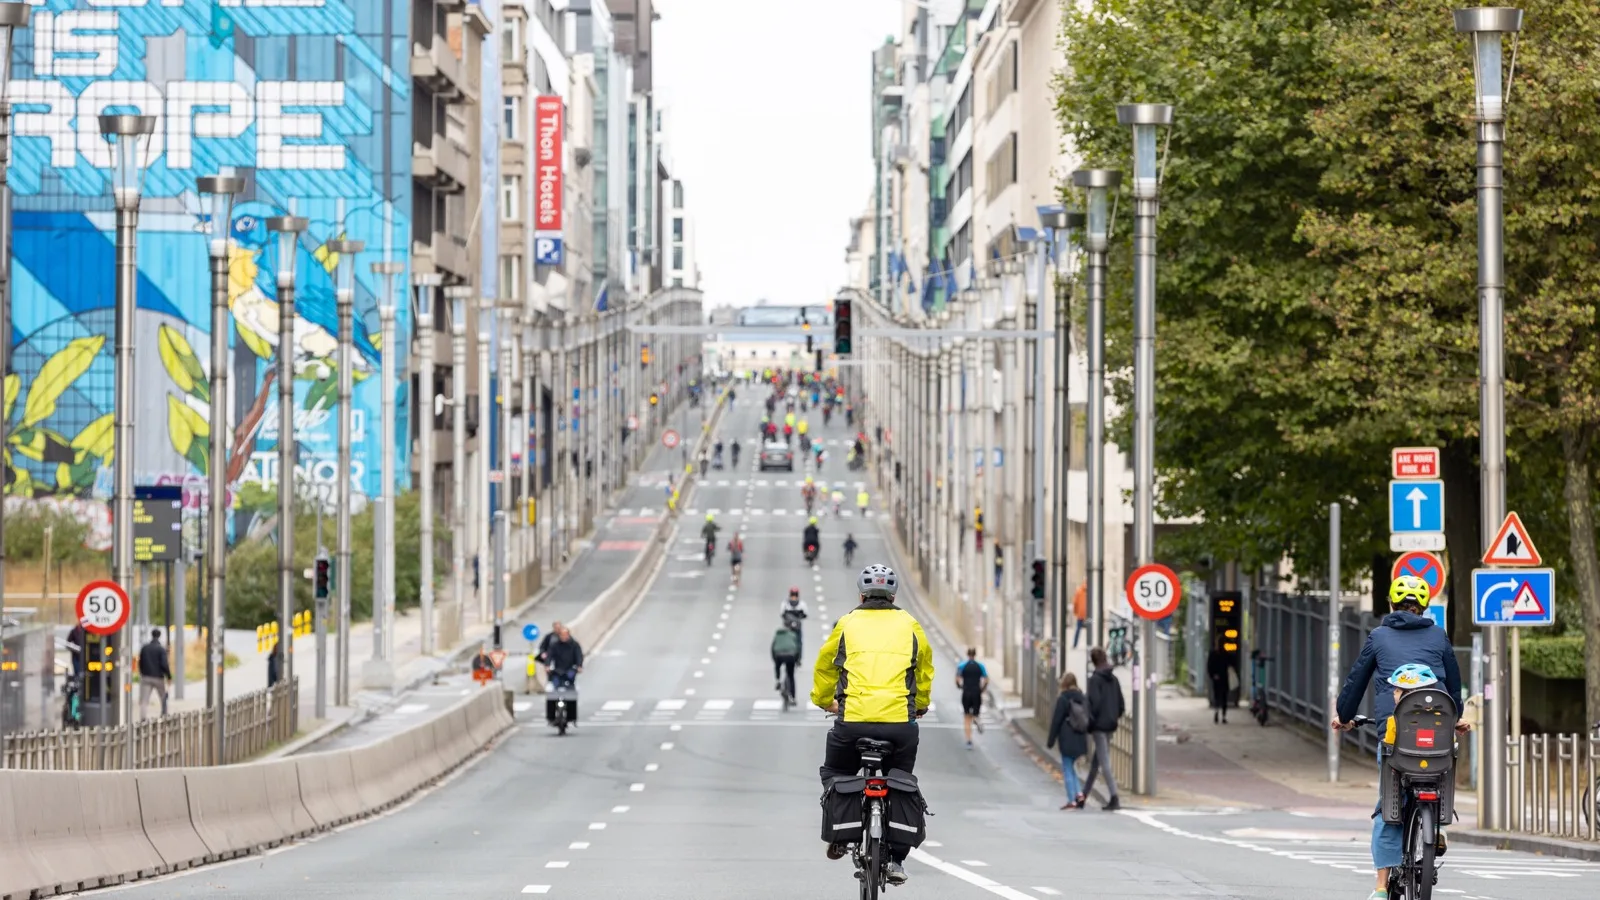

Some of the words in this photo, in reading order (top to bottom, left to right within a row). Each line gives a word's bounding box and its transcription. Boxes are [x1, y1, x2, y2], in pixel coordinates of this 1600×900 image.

[33, 10, 119, 76] IS
[540, 113, 558, 161] Thon
[540, 165, 558, 224] Hotels
[537, 239, 554, 260] P
[1140, 580, 1167, 598] 50
[89, 596, 117, 613] 50
[1146, 599, 1162, 607] km
[95, 615, 110, 623] km
